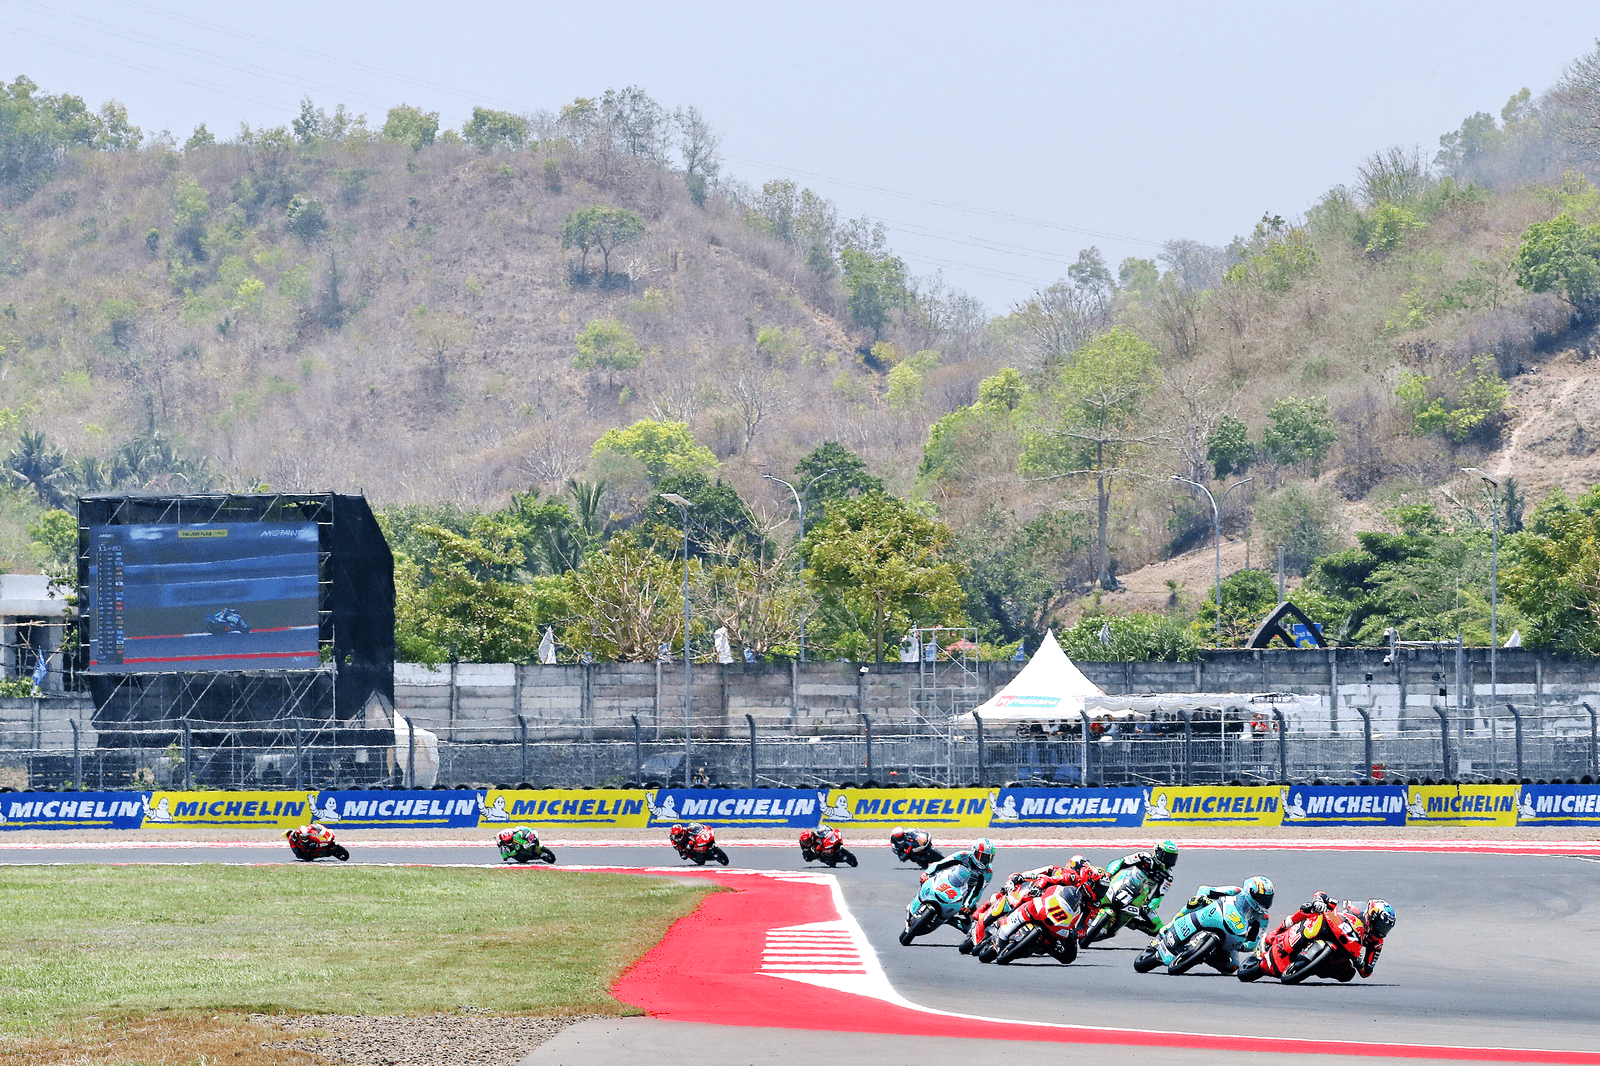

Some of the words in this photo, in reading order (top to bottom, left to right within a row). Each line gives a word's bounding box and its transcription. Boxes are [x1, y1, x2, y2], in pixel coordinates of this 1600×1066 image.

[8, 801, 141, 818] MICHELIN
[174, 801, 306, 817] MICHELIN
[342, 800, 475, 816] MICHELIN
[511, 799, 644, 815] MICHELIN
[681, 799, 816, 815] MICHELIN
[855, 798, 987, 815] MICHELIN
[1020, 798, 1140, 815] MICHELIN
[1171, 797, 1279, 813] MICHELIN
[1307, 796, 1402, 814] MICHELIN
[1427, 796, 1513, 813] MICHELIN
